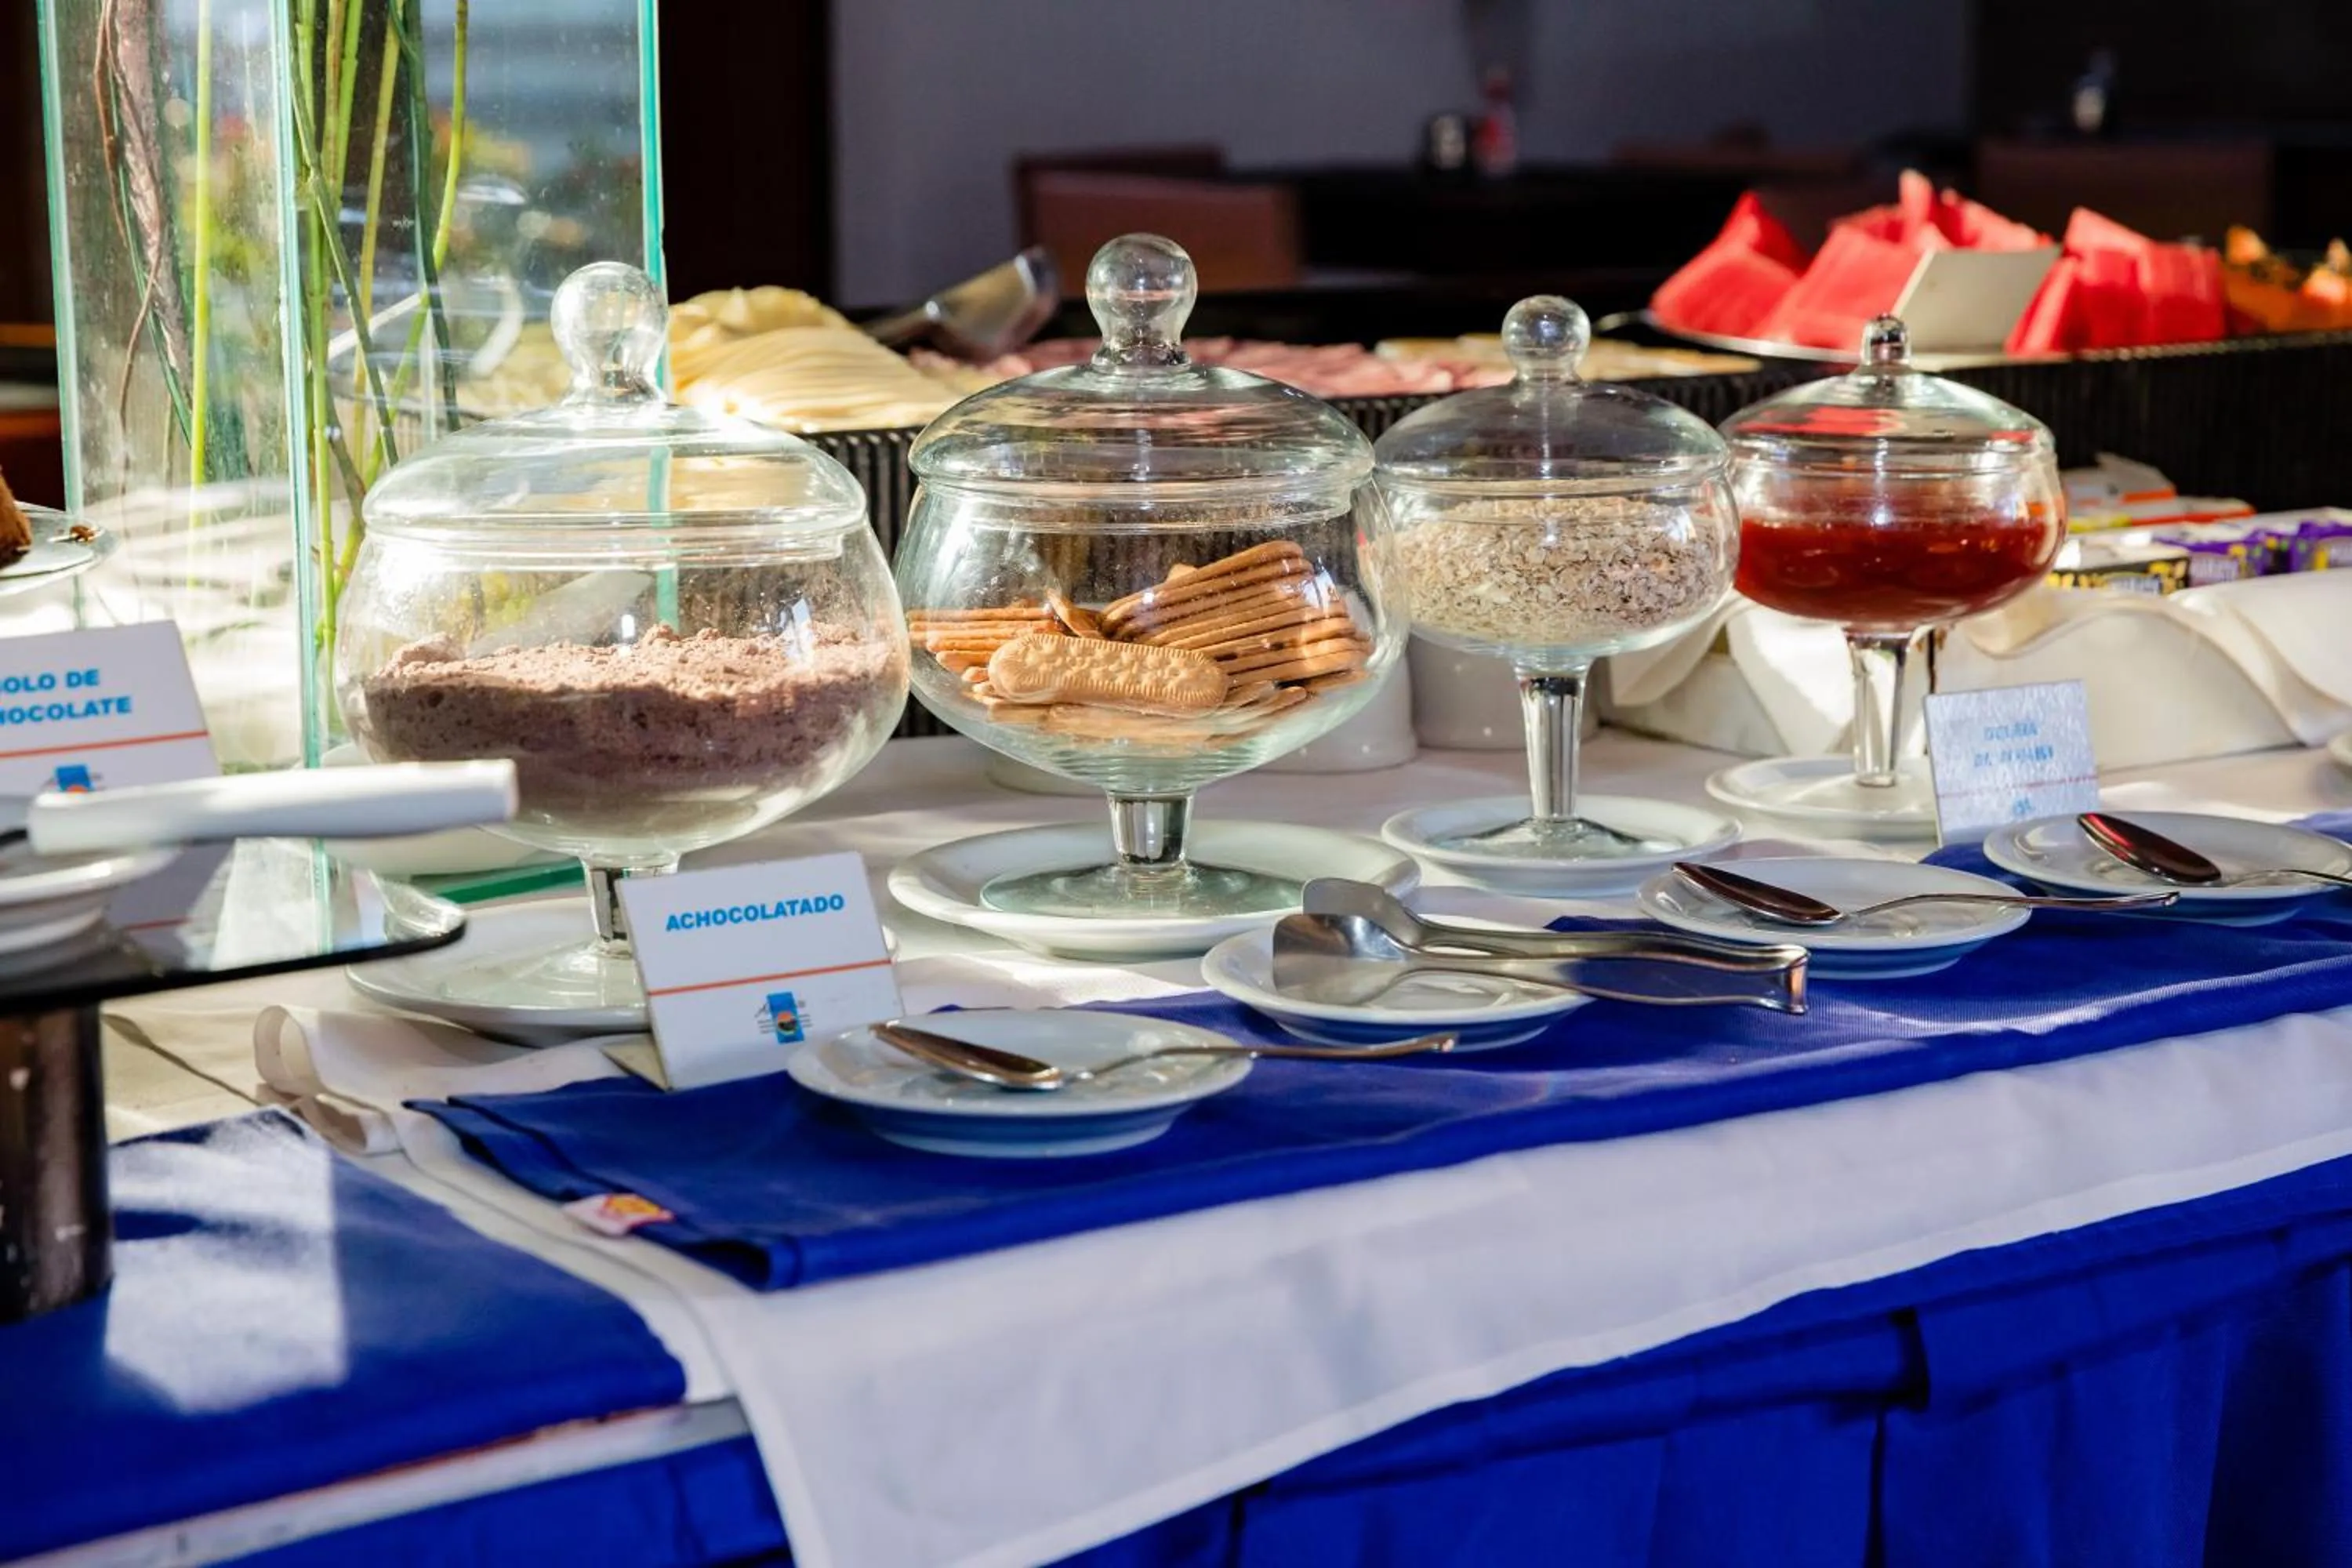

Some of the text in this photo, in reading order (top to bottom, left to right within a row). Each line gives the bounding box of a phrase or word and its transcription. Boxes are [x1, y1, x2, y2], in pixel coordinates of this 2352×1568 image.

[0, 668, 100, 693] OLO DE
[666, 894, 845, 932] ACHOCOLATADO
